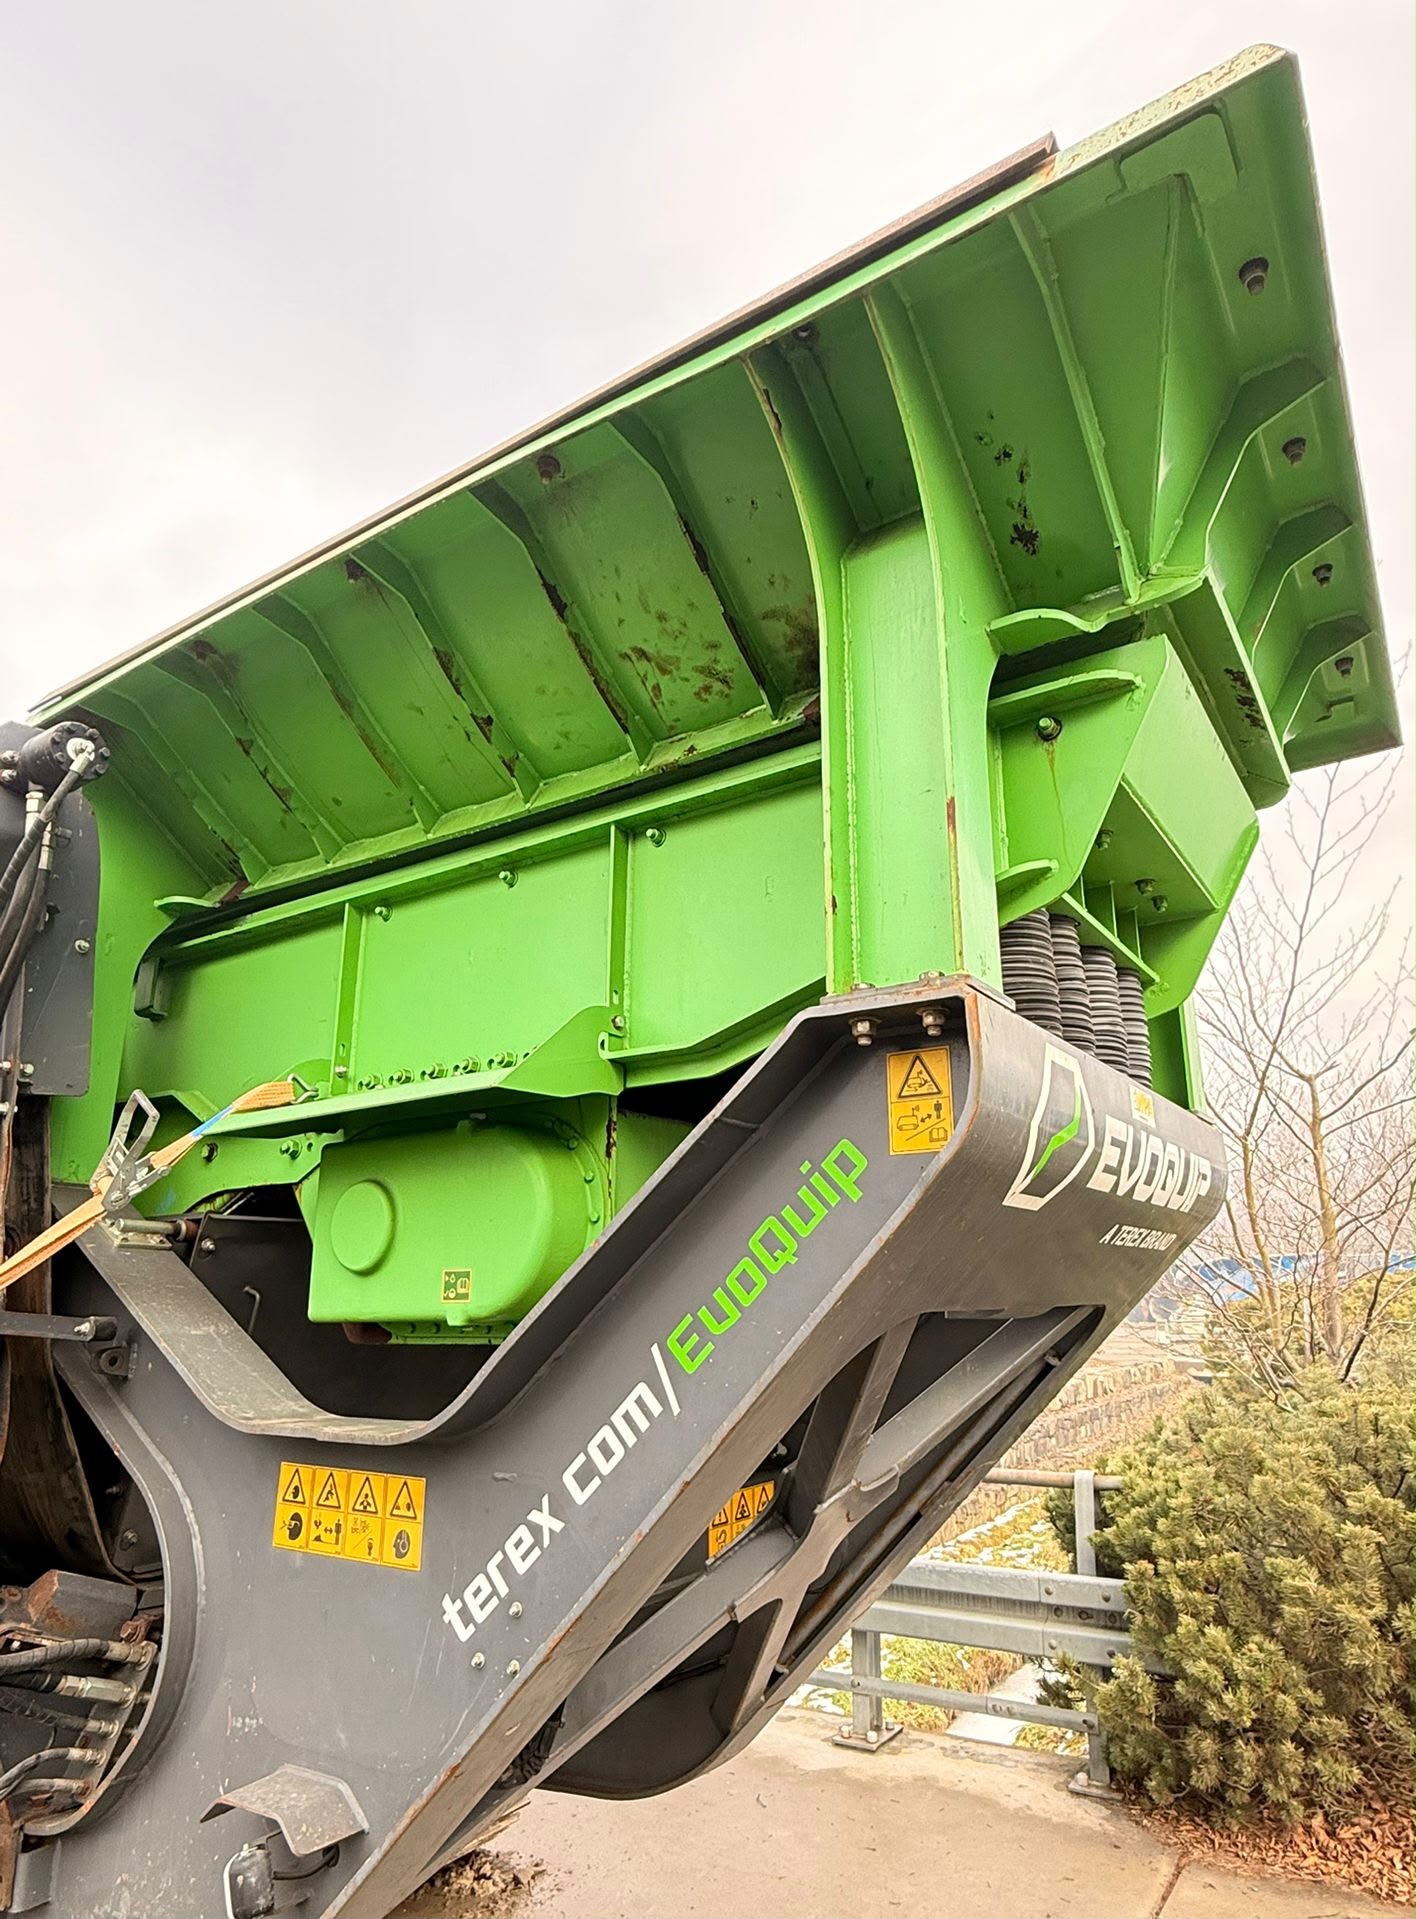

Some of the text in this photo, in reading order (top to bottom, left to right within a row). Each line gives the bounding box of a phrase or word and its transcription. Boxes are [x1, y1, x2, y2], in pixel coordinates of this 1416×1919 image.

[1086, 1114, 1212, 1213] EVOQUIP
[1099, 1223, 1177, 1251] A TEREX BRAND
[441, 1493, 565, 1642] terex
